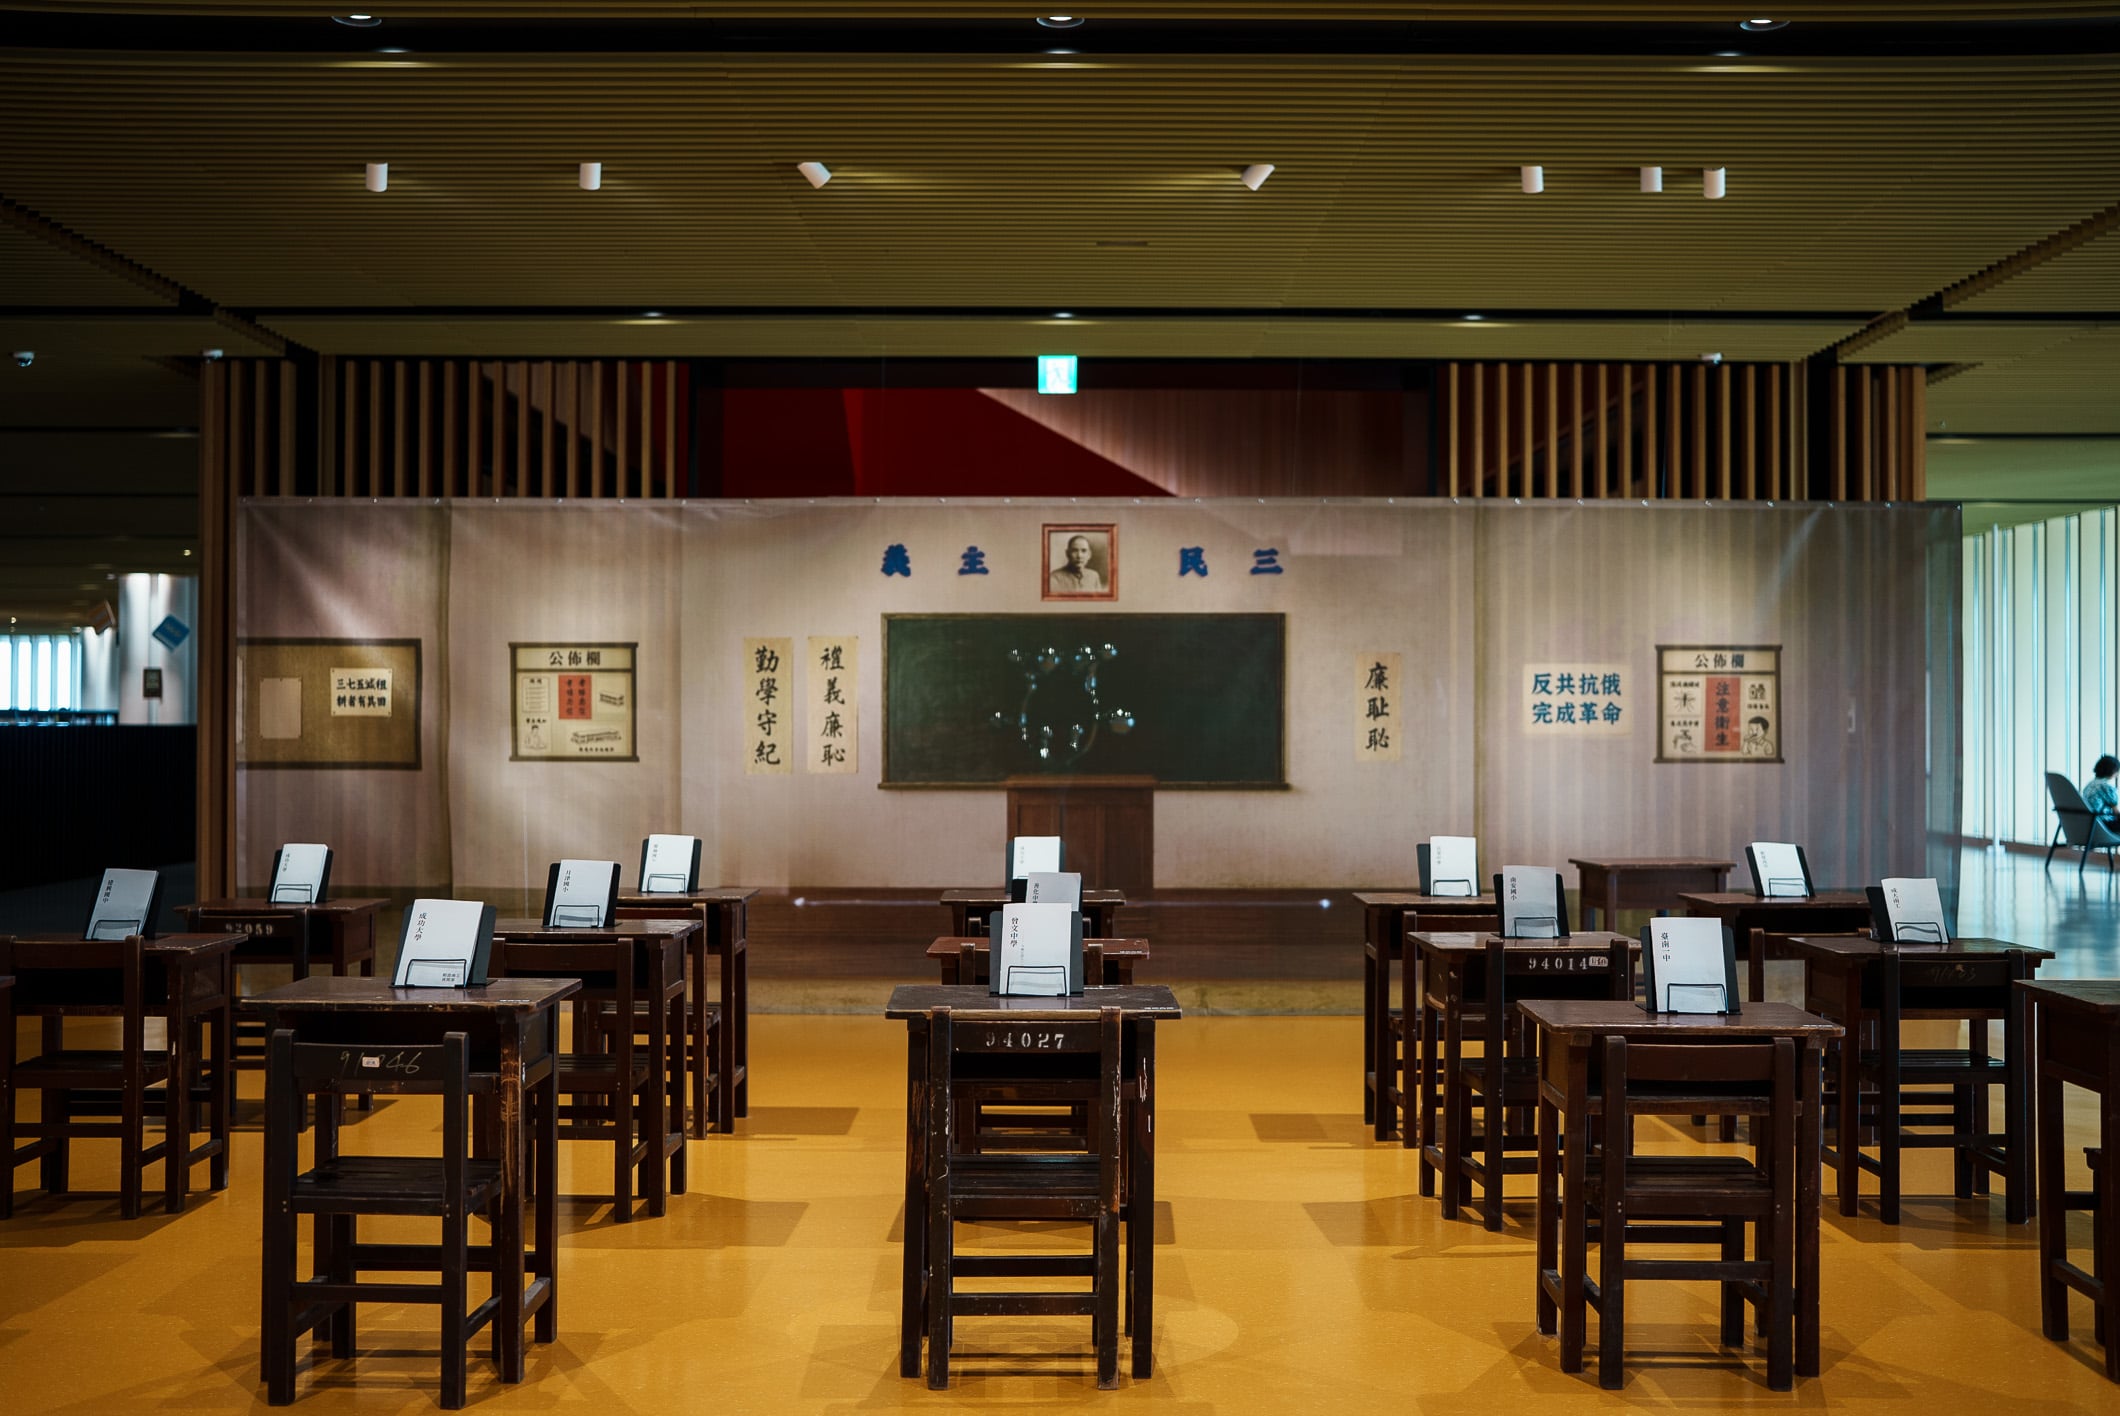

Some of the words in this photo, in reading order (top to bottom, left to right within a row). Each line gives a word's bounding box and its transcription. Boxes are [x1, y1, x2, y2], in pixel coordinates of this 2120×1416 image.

[549, 651, 600, 666] 公佈欄
[1695, 653, 1745, 668] 公佈欄
[1531, 672, 1622, 696] 反共抗俄
[755, 645, 780, 765] 勤學守紀
[1531, 701, 1622, 725] 完成革命
[1032, 883, 1040, 903] 善化中
[414, 912, 427, 941] 成功大學
[1010, 917, 1019, 947] 曾文中學
[1529, 957, 1587, 970] 94014
[986, 1032, 1064, 1049] 94027
